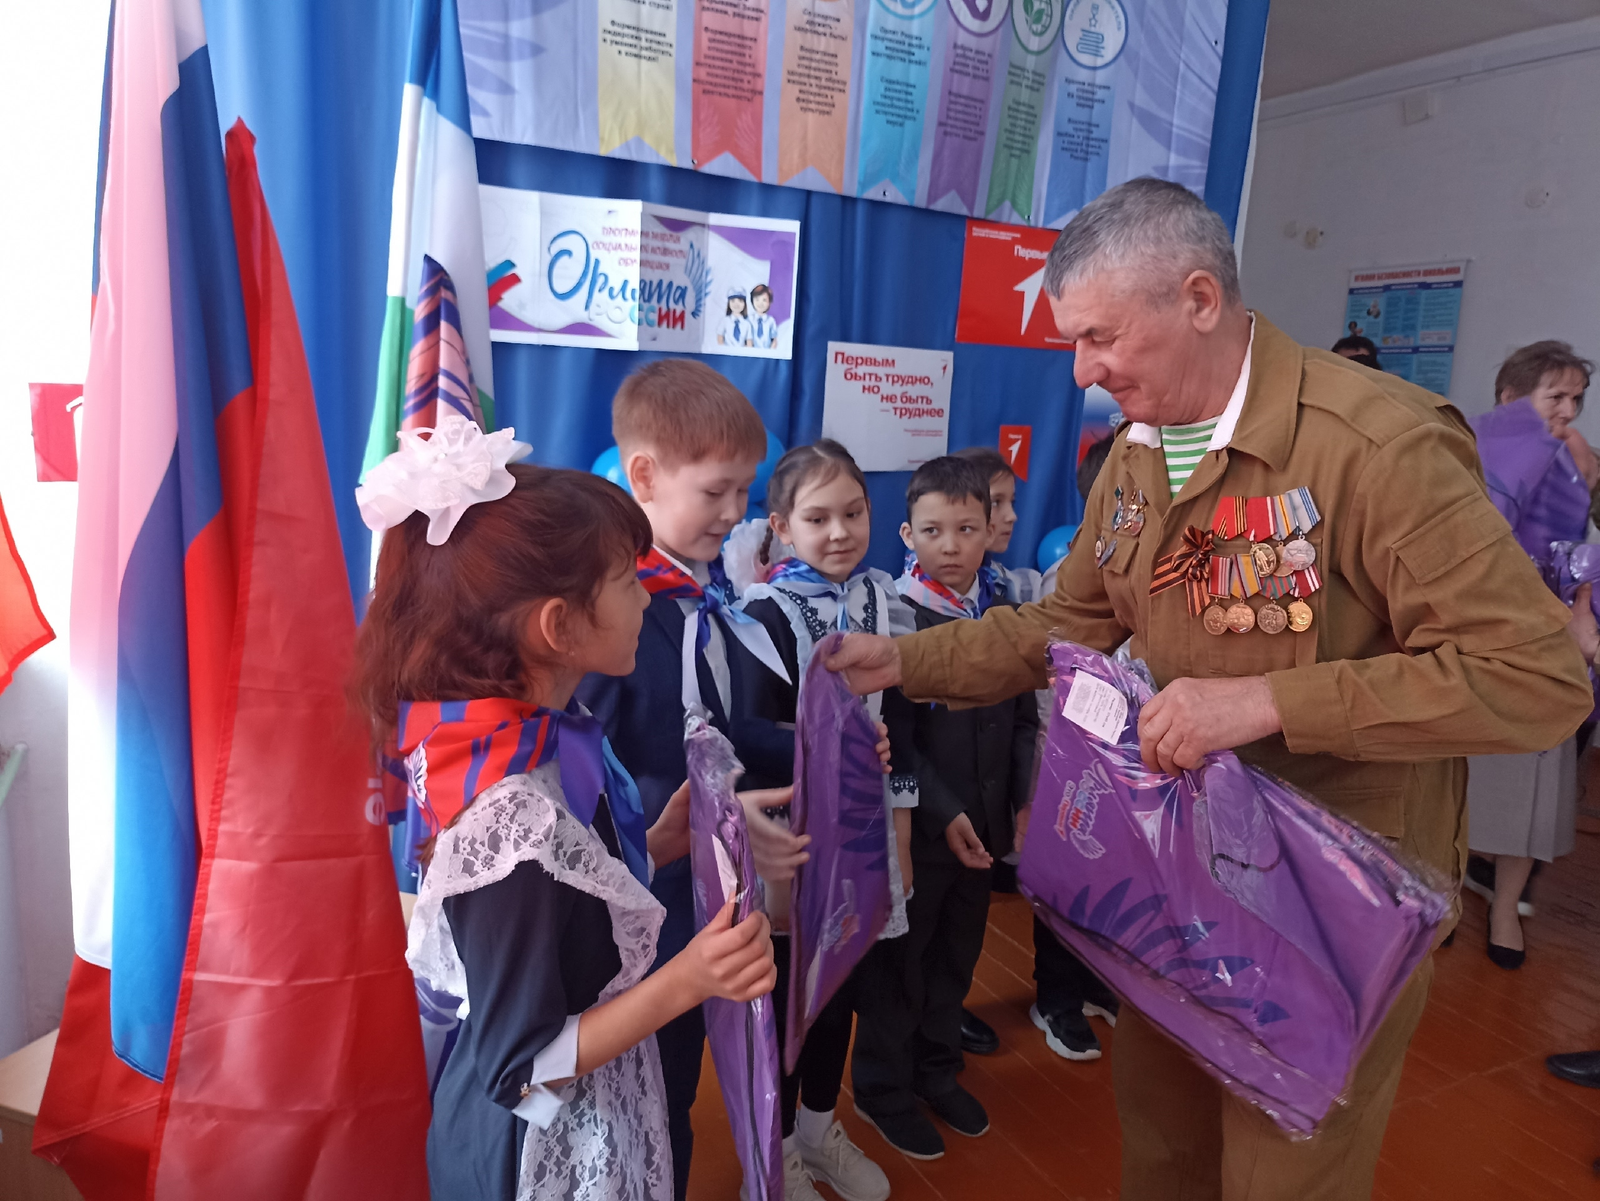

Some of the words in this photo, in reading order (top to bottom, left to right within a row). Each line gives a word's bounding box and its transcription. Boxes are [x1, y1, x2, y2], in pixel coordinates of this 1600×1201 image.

[834, 351, 896, 368] Первым
[843, 367, 883, 382] быть
[885, 373, 934, 388] трудно,
[862, 384, 881, 395] но
[880, 394, 898, 404] не
[900, 391, 932, 405] быть
[892, 406, 945, 419] труднее
